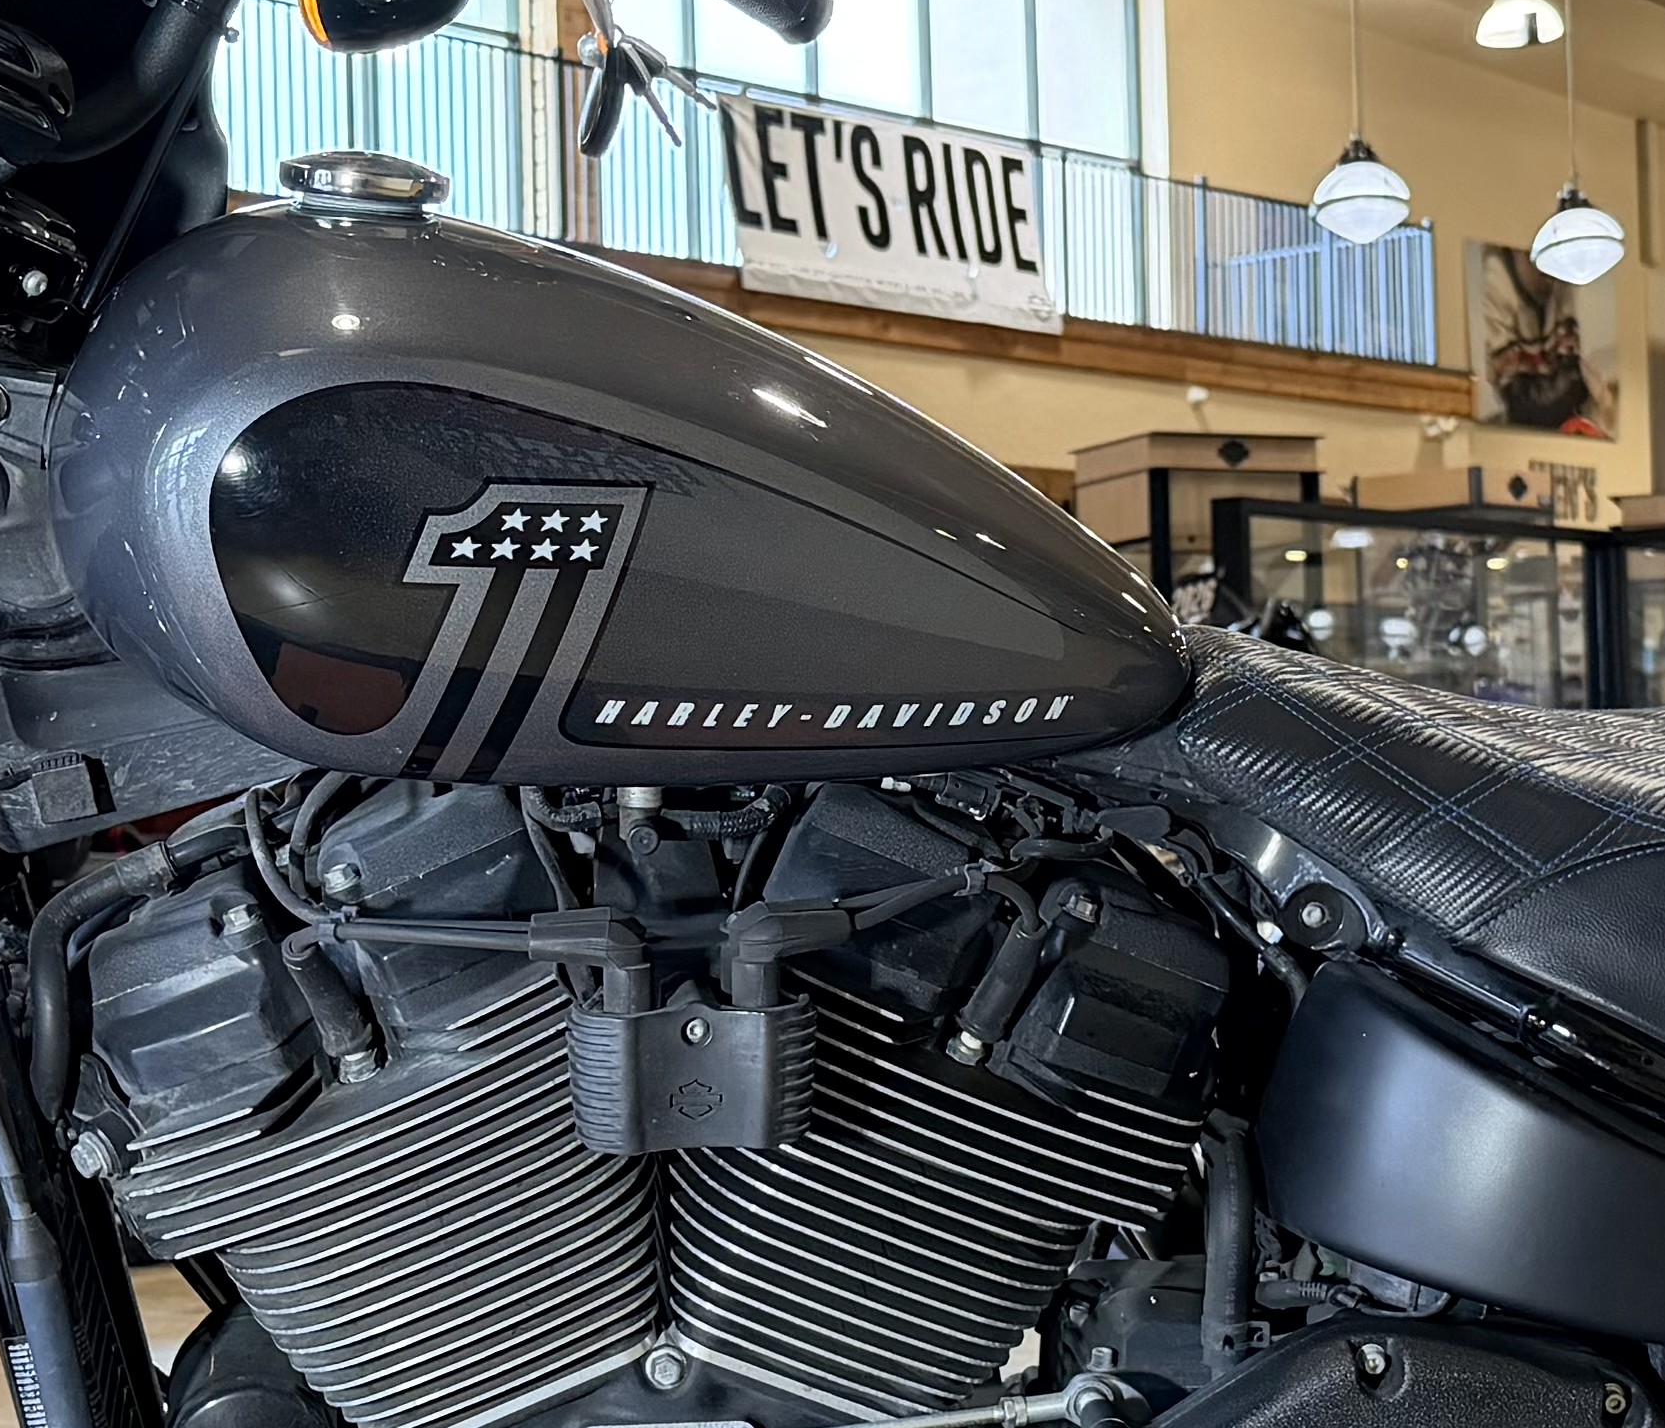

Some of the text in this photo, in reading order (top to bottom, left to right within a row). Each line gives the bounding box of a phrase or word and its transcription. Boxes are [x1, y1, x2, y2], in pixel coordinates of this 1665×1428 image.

[720, 102, 1040, 277] LET'S RIDE
[595, 696, 1069, 729] HARLEY-DAVIDSON
